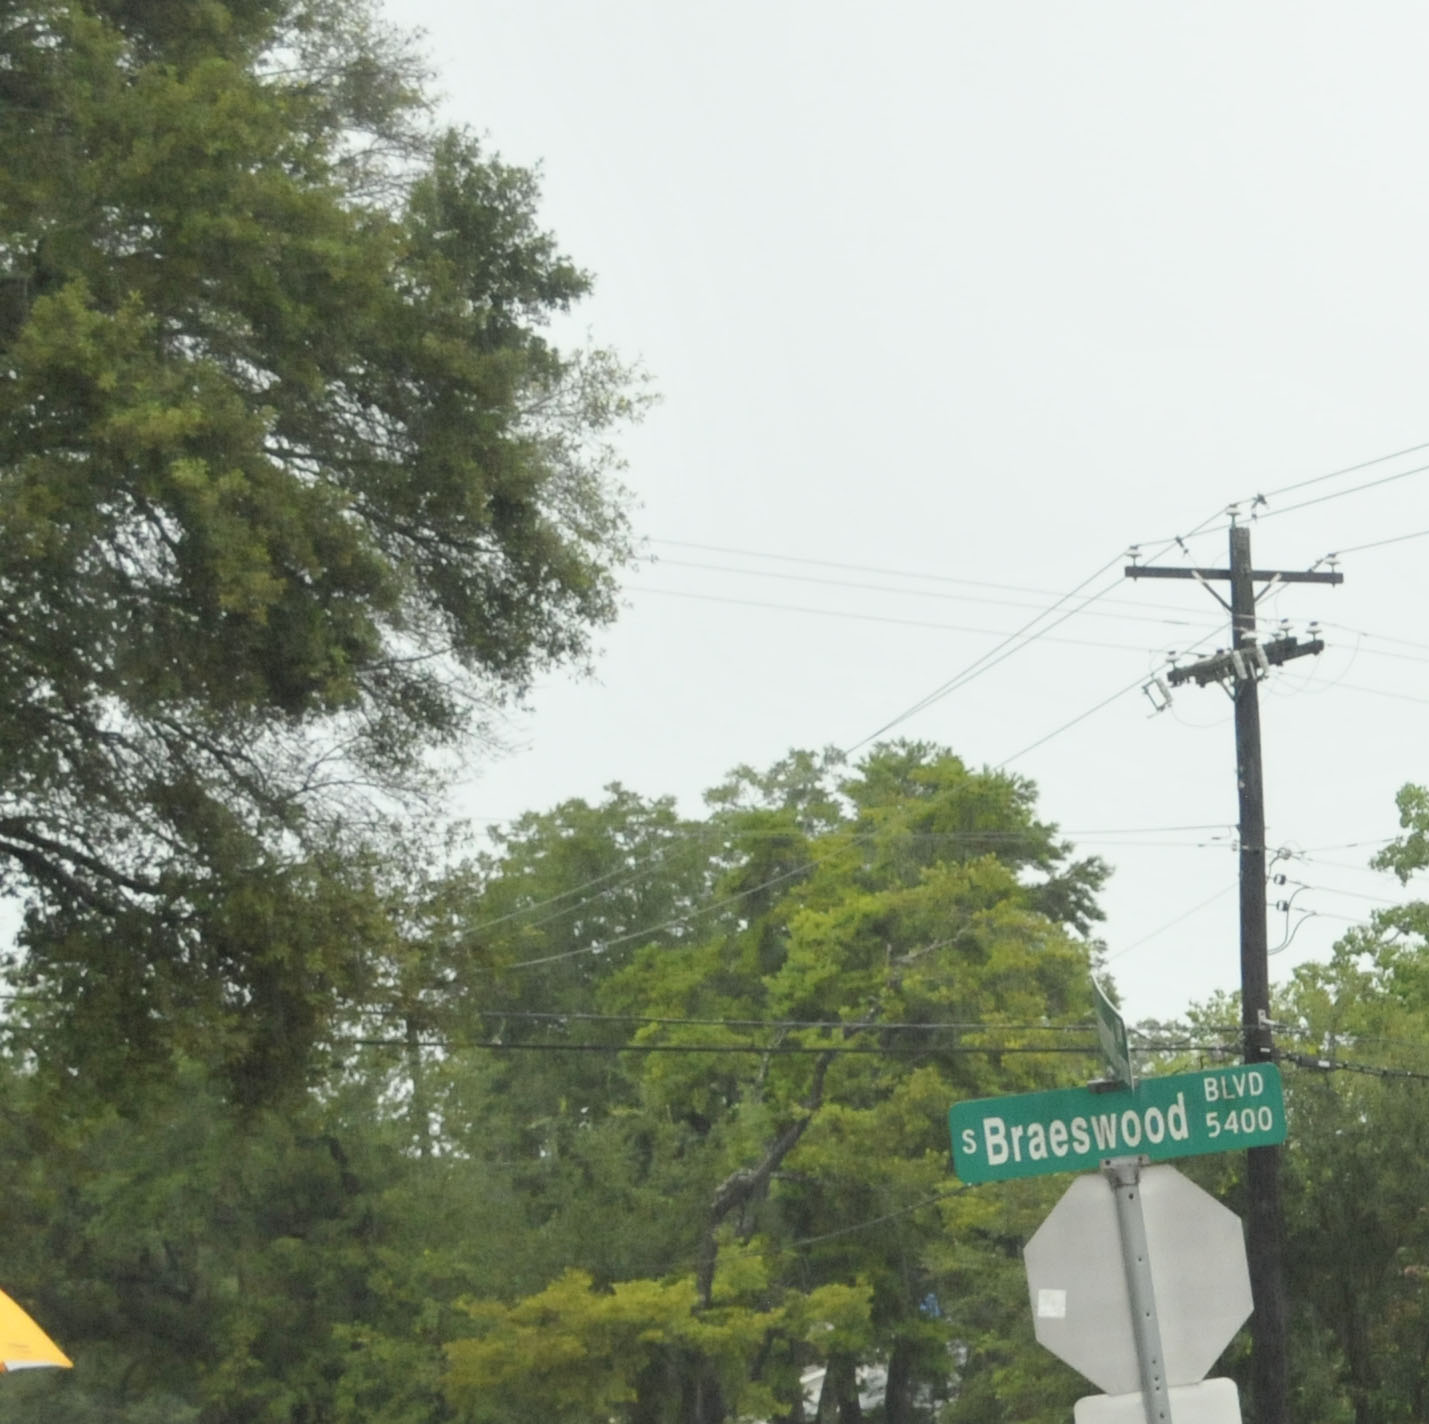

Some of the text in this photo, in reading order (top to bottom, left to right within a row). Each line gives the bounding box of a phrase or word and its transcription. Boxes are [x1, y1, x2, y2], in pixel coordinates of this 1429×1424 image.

[1203, 1071, 1264, 1102] BLVD
[961, 1091, 1190, 1166] S Braeswood
[1205, 1105, 1274, 1138] 5400
